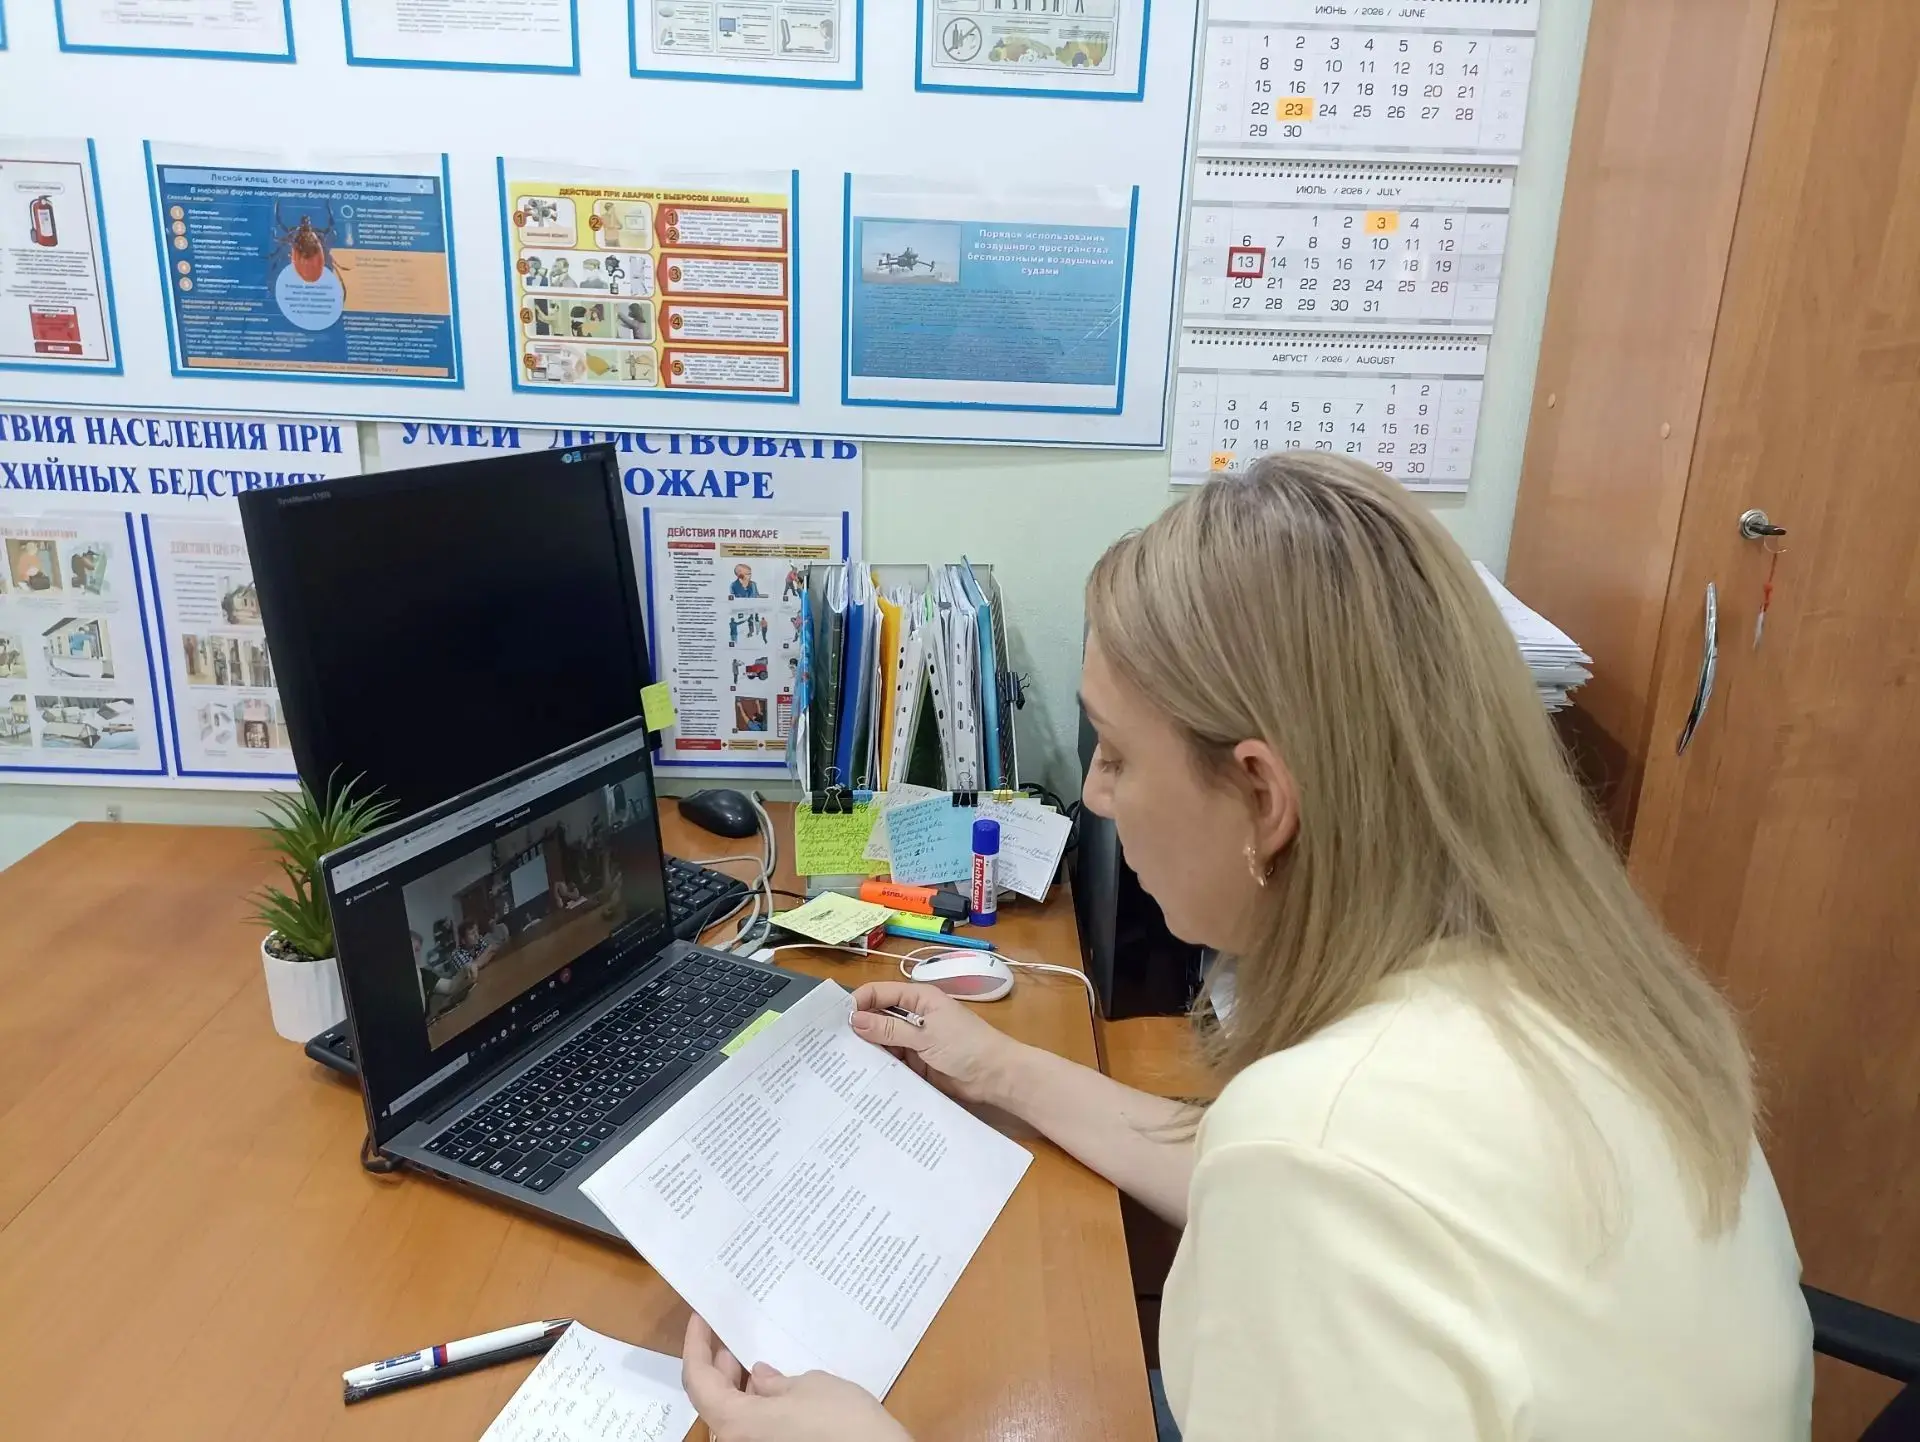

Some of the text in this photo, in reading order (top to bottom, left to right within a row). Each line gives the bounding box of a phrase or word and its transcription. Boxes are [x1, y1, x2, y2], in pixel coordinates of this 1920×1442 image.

[1315, 5, 1347, 15] ИЮНЬ
[1398, 9, 1426, 18] JUNE
[1264, 36, 1477, 53] 1 2 3 4 5 6 7
[1260, 58, 1478, 76] 8 9 10 11 12 13 14
[1256, 80, 1473, 98] 15 16 17 18 19 20 21
[1252, 102, 1473, 120] 22 23 24 25 26 27 28
[1250, 125, 1301, 137] 29 30
[211, 174, 242, 182] Лесной
[272, 176, 287, 184] Все
[307, 179, 335, 187] нужно
[198, 187, 229, 195] мировой
[230, 189, 253, 197] фауне
[308, 191, 329, 199] более
[384, 195, 411, 203] клещей
[560, 187, 602, 197] ДЕЙСТВИЯ
[604, 190, 620, 198] ПРИ
[622, 191, 654, 200] АВАРИИ
[664, 194, 709, 203] ВЫБРОСОМ
[710, 195, 750, 204] АММИАКА
[1296, 185, 1327, 195] ИЮЛЬ
[1376, 188, 1401, 196] JULY
[1313, 216, 1452, 230] 1 2 3 4 5
[979, 229, 1105, 242] Порядок использования
[974, 242, 1109, 254] воздушного пространства
[1243, 236, 1454, 251] 6 7 8 9 10 11 12
[967, 252, 1114, 266] беспилотными воздушными
[1239, 256, 1451, 272] 13 14 15 16 17 18 19
[1021, 266, 1059, 276] судами
[1233, 277, 1448, 292] 20 21 22 23 24 25 26
[1233, 297, 1378, 311] 27 28 29 30 31
[1271, 354, 1308, 363] АВГУСТ
[1356, 356, 1396, 365] AUGUST
[1392, 385, 1429, 396] 1 2
[1228, 400, 1427, 415] 3 4 5 6 7 8 9
[1224, 419, 1428, 434] 10 11 12 13 14 15 16
[84, 416, 267, 450] НАСЕЛЕНИЯ
[278, 424, 343, 454] ПРИ
[1223, 439, 1236, 448] 17
[1254, 439, 1268, 449] 18
[1285, 440, 1301, 449] 19
[1347, 442, 1361, 452] 21
[1378, 443, 1394, 453] 22
[1410, 443, 1426, 454] 23
[1377, 461, 1393, 473] 29
[1408, 463, 1424, 473] 30
[0, 456, 141, 494] ХИЙНЫХ
[624, 467, 774, 499] ОЖАРЕ
[667, 526, 778, 539] ДЕЙСТВИЯ ПРИ ПОЖАРЕ
[973, 857, 984, 910] ErichKrause
